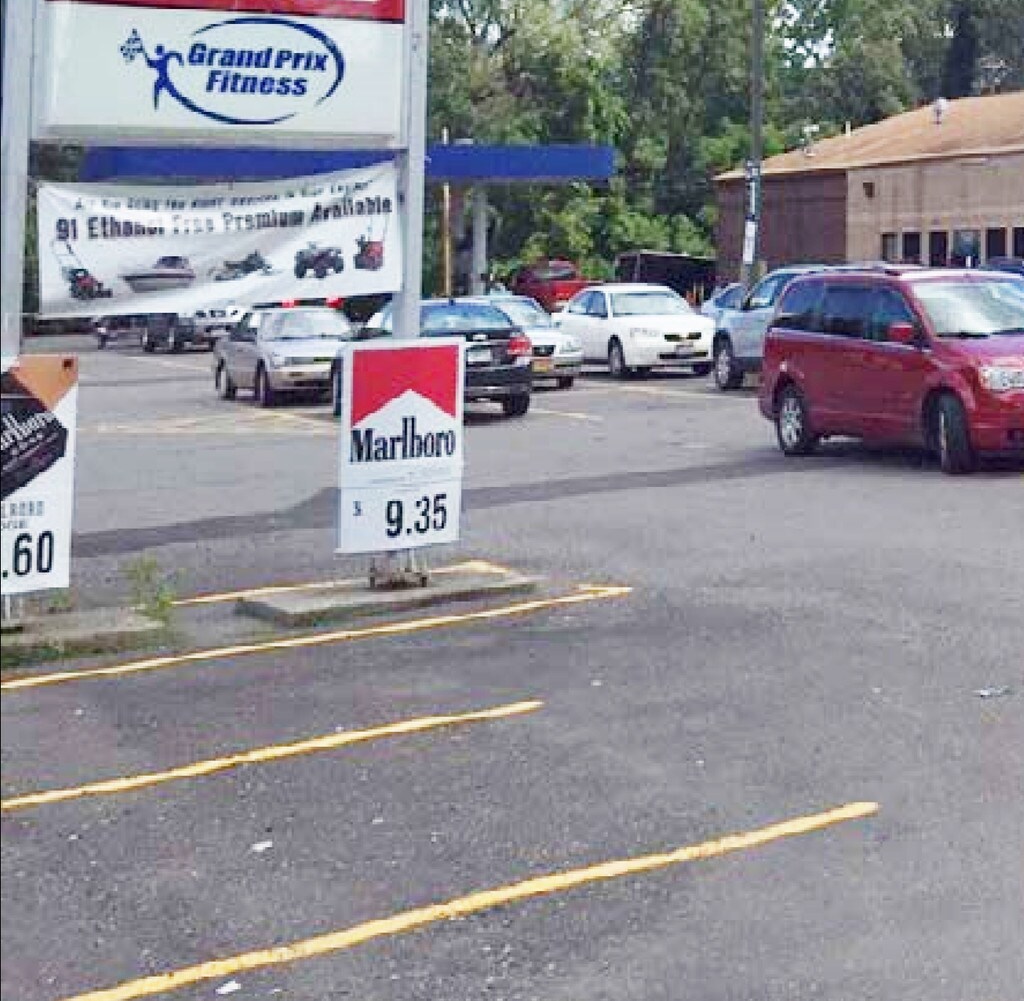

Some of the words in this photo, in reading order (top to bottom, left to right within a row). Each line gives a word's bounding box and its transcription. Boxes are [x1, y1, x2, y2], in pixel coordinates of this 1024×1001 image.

[205, 69, 308, 95] Fitness
[56, 218, 78, 240] 91
[222, 209, 305, 232] Premium
[311, 195, 393, 223] Available
[349, 415, 456, 464] Marlboro
[386, 493, 447, 537] 9.35
